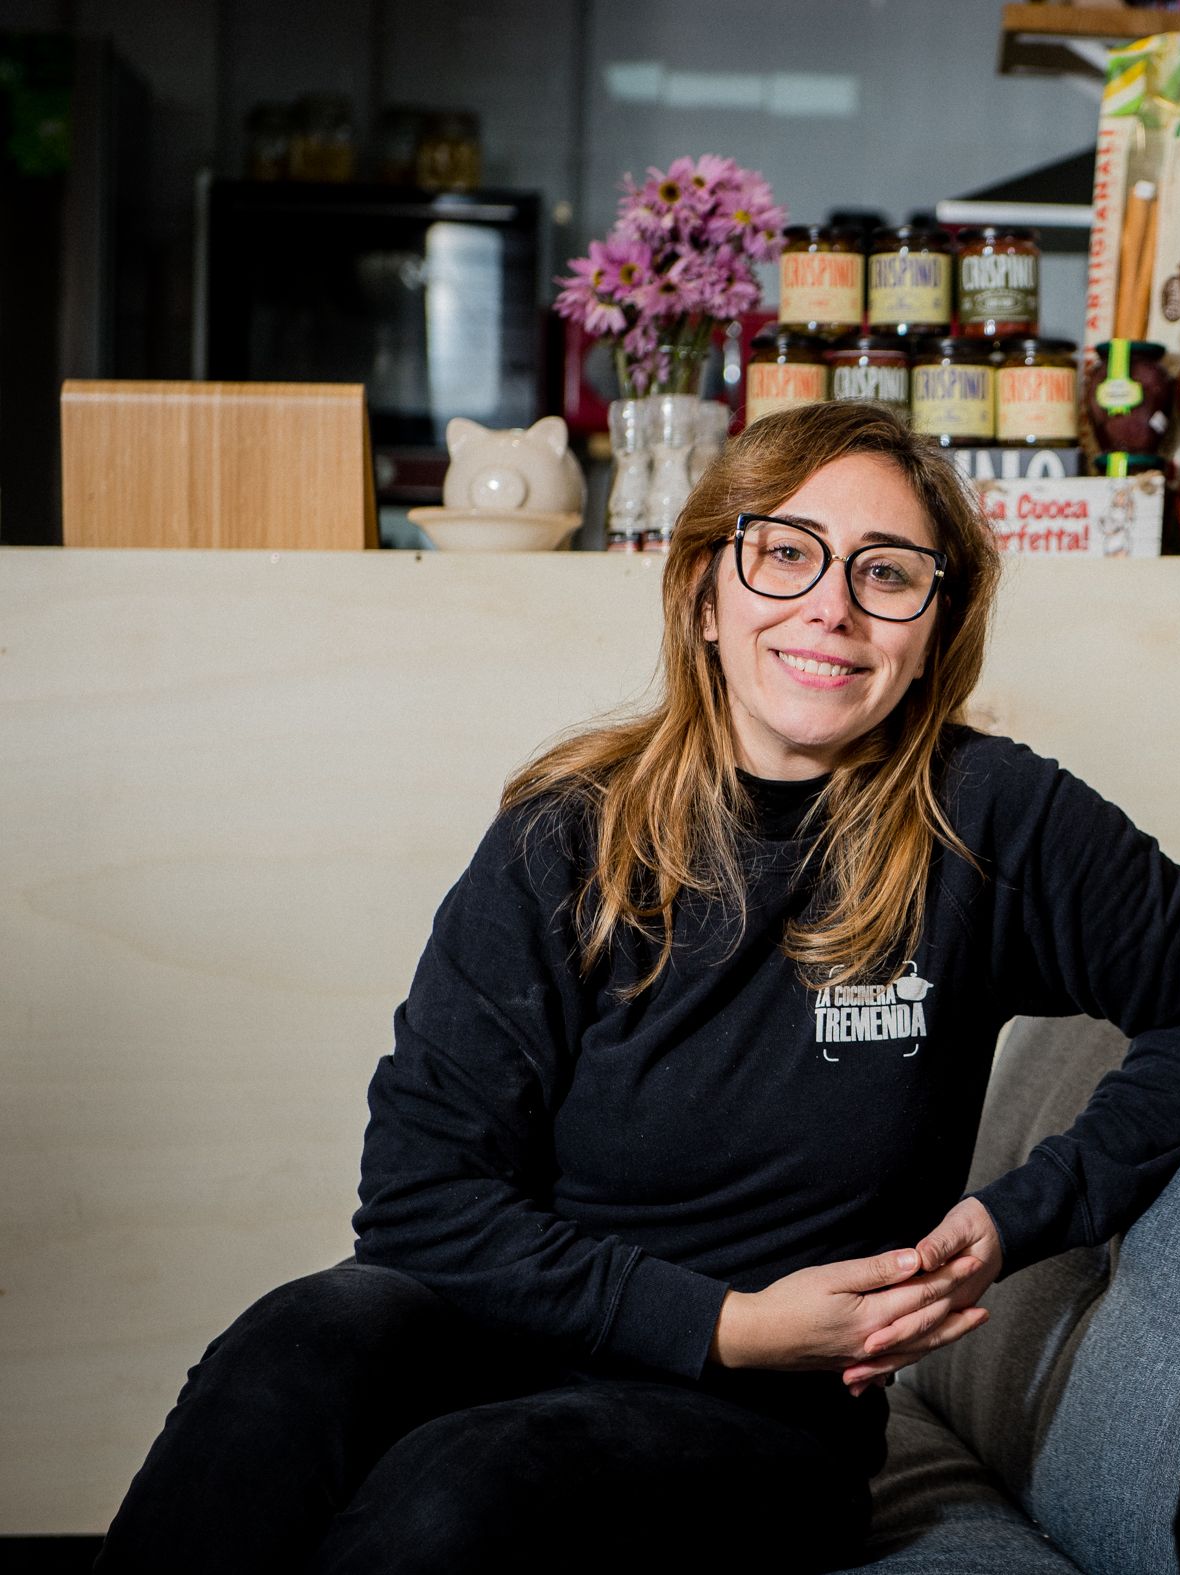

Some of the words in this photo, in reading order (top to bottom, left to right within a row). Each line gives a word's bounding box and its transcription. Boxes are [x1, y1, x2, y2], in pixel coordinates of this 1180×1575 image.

[1016, 492, 1089, 520] Cuoca
[815, 986, 831, 1008] LA
[834, 983, 897, 1007] COCINERA
[814, 1002, 927, 1043] TREMENDA
